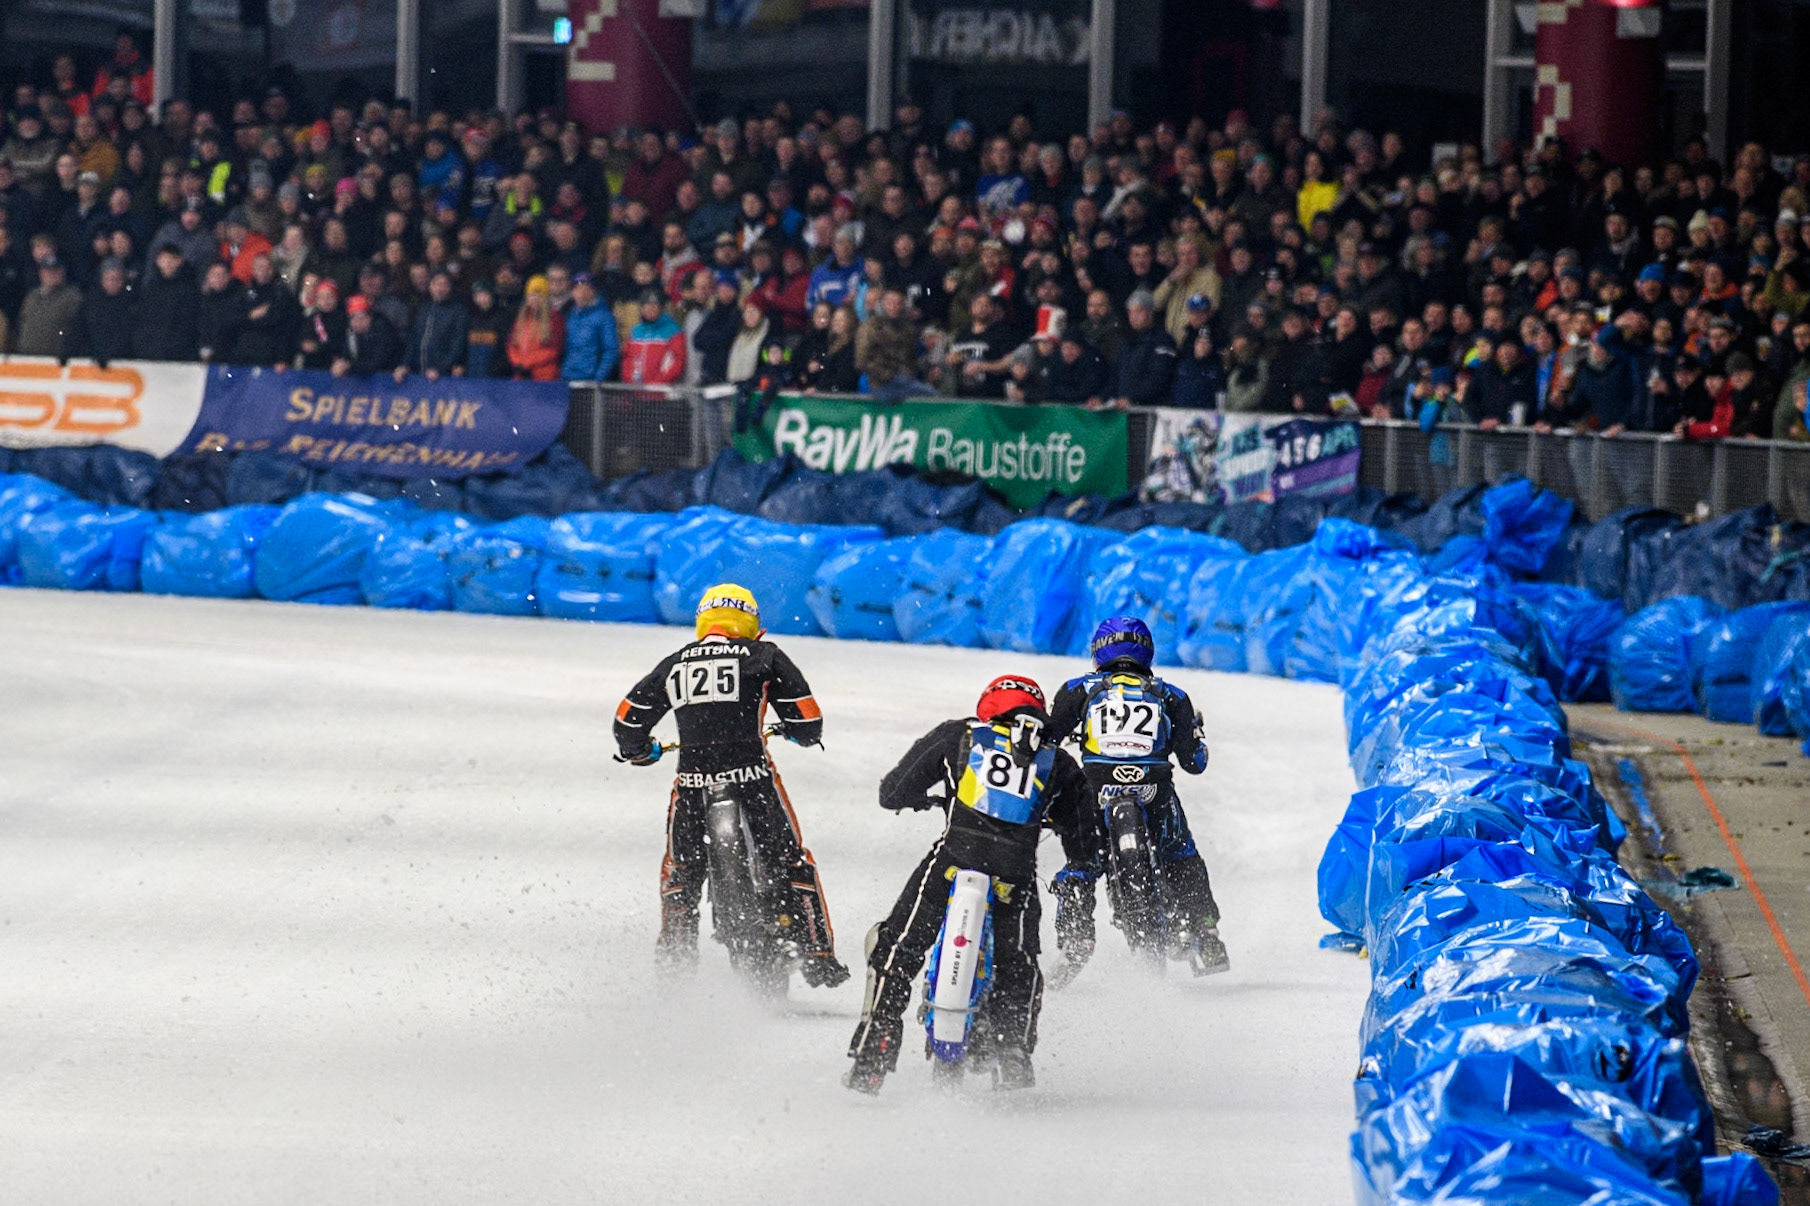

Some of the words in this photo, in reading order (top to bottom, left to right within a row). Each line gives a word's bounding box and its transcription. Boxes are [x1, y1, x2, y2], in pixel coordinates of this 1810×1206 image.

[284, 387, 482, 430] SPIELBANK
[927, 427, 1086, 483] Baustoffe
[681, 644, 751, 661] REITSMA
[669, 665, 736, 702] 125
[1095, 704, 1154, 737] 192
[678, 764, 770, 789] SEBASTIAN
[986, 753, 1029, 796] 81
